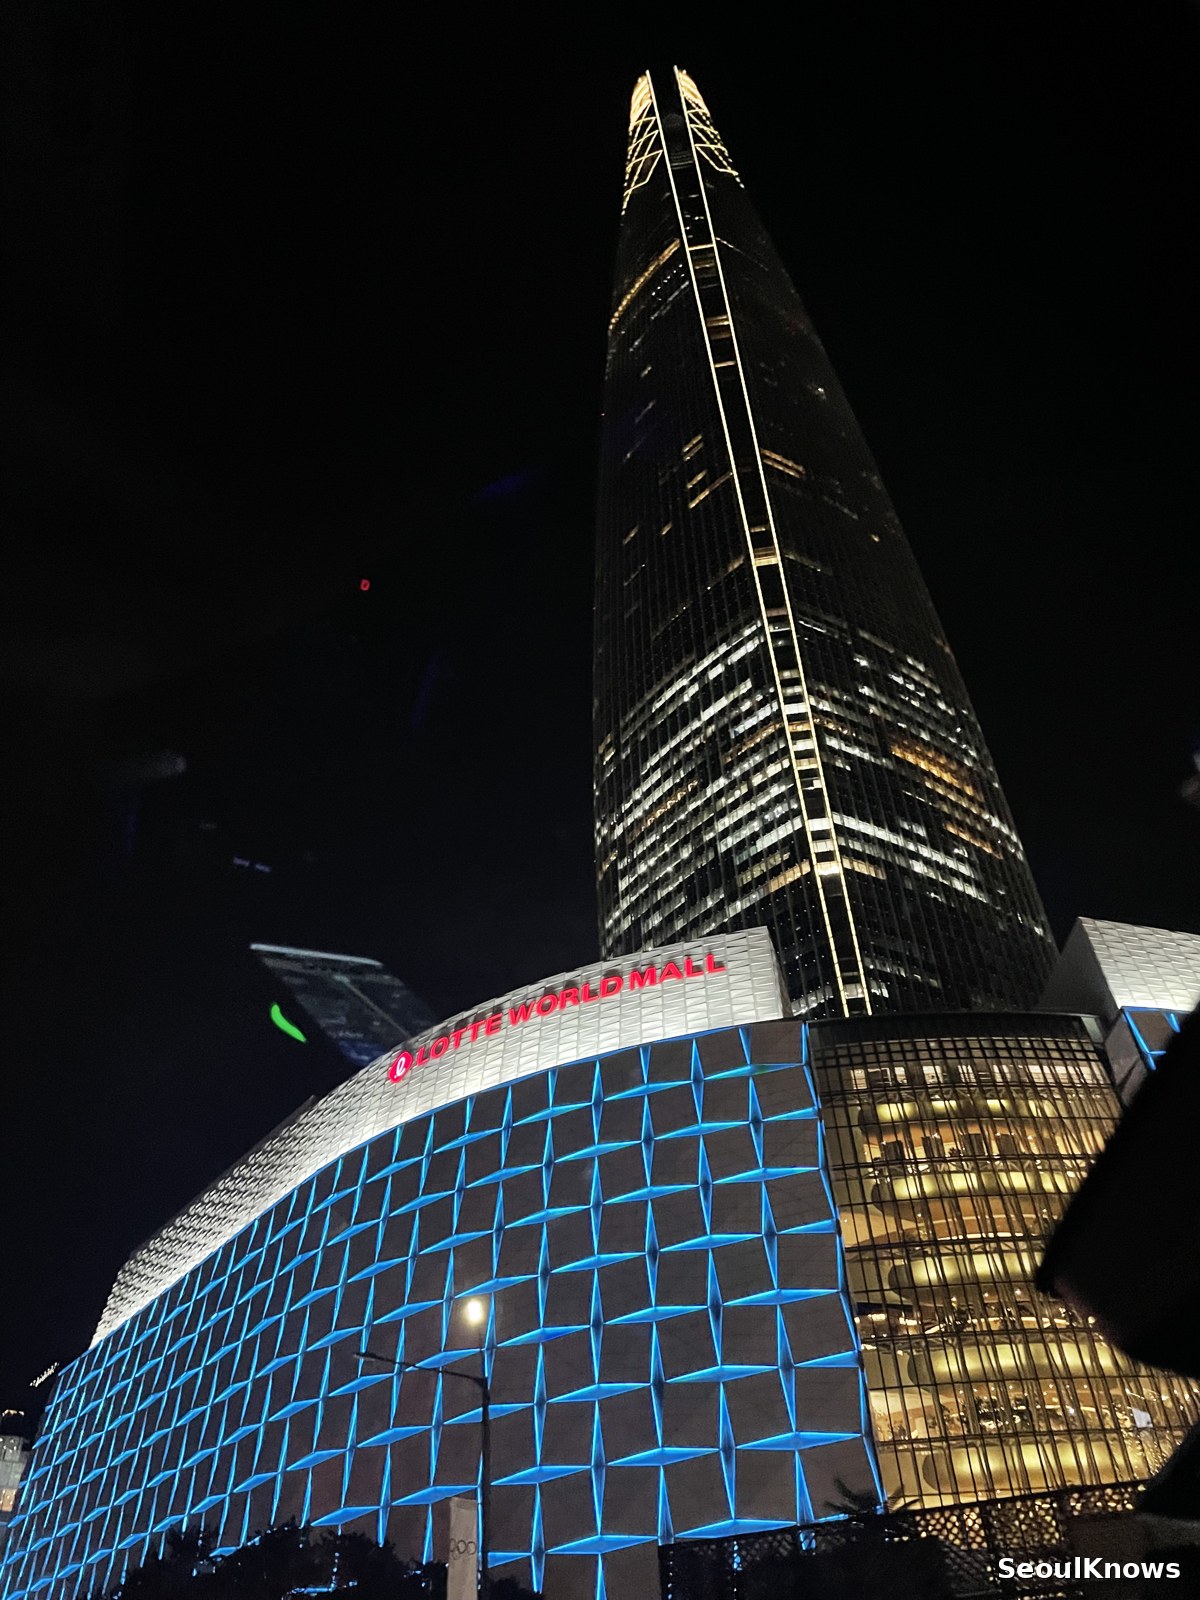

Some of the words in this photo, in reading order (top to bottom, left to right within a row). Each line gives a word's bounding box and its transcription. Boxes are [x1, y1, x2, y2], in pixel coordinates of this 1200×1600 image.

[415, 1012, 503, 1067] LOTTE
[507, 975, 625, 1027] WORLD
[628, 953, 727, 991] MALL
